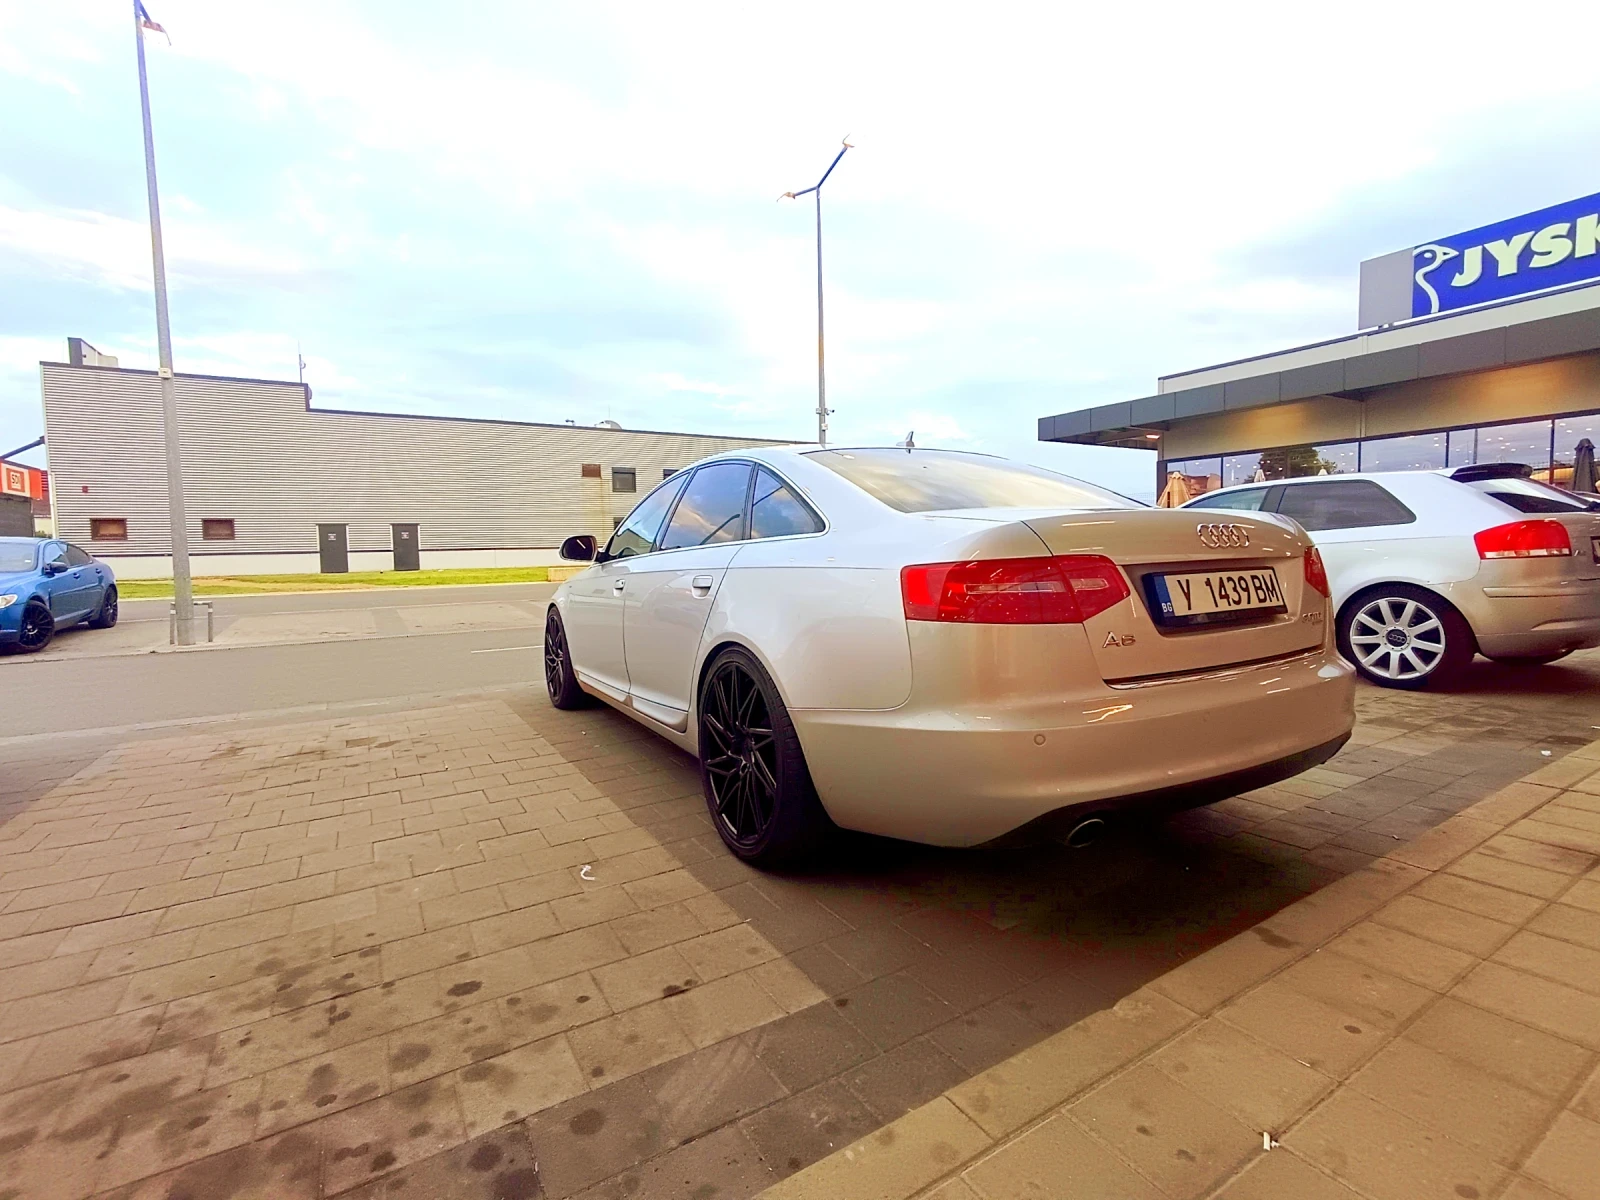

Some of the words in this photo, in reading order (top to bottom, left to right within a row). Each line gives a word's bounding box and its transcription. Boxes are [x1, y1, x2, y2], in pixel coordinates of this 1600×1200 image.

[1177, 579, 1192, 611] Y
[1205, 575, 1251, 608] 1439
[1250, 574, 1280, 604] BM
[1161, 602, 1173, 612] BG
[1102, 631, 1136, 648] A6
